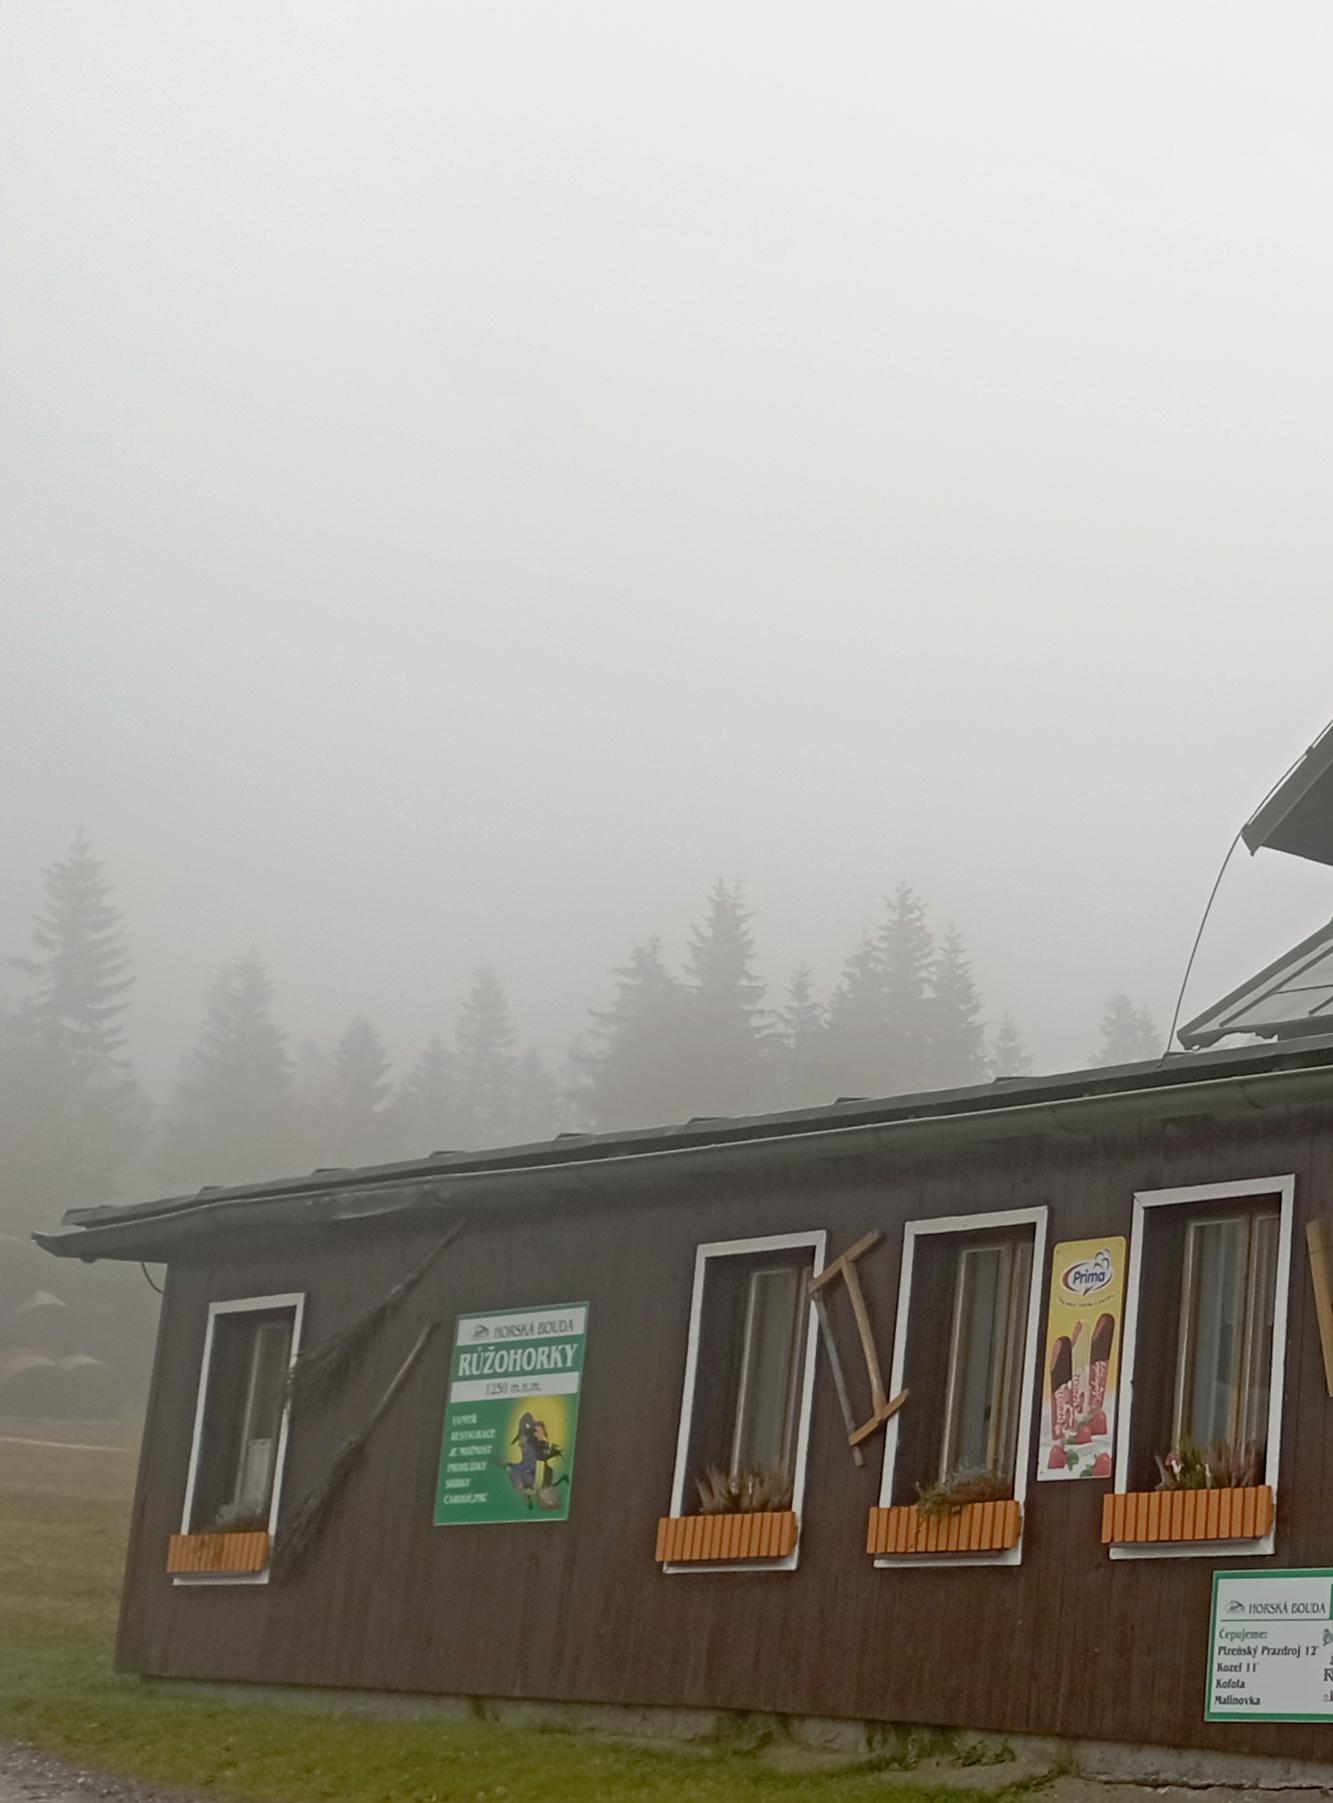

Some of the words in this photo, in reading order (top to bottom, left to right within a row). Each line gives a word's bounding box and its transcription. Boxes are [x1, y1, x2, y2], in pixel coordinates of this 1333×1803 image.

[1073, 1269, 1105, 1285] Prima
[493, 1322, 534, 1339] HORSKÁ
[537, 1319, 574, 1335] BOUDA
[458, 1344, 578, 1377] RŮŽOHORKY
[1249, 1600, 1288, 1614] HORSKÁ
[1291, 1602, 1326, 1614] BOUDA
[1219, 1627, 1268, 1642] Čepujeme:
[1218, 1645, 1258, 1659] Plzeňský
[1261, 1645, 1301, 1658] Prazdroj
[1217, 1662, 1242, 1673] Kozel
[1216, 1678, 1246, 1689] Kofola
[1215, 1695, 1261, 1706] Malinovka
